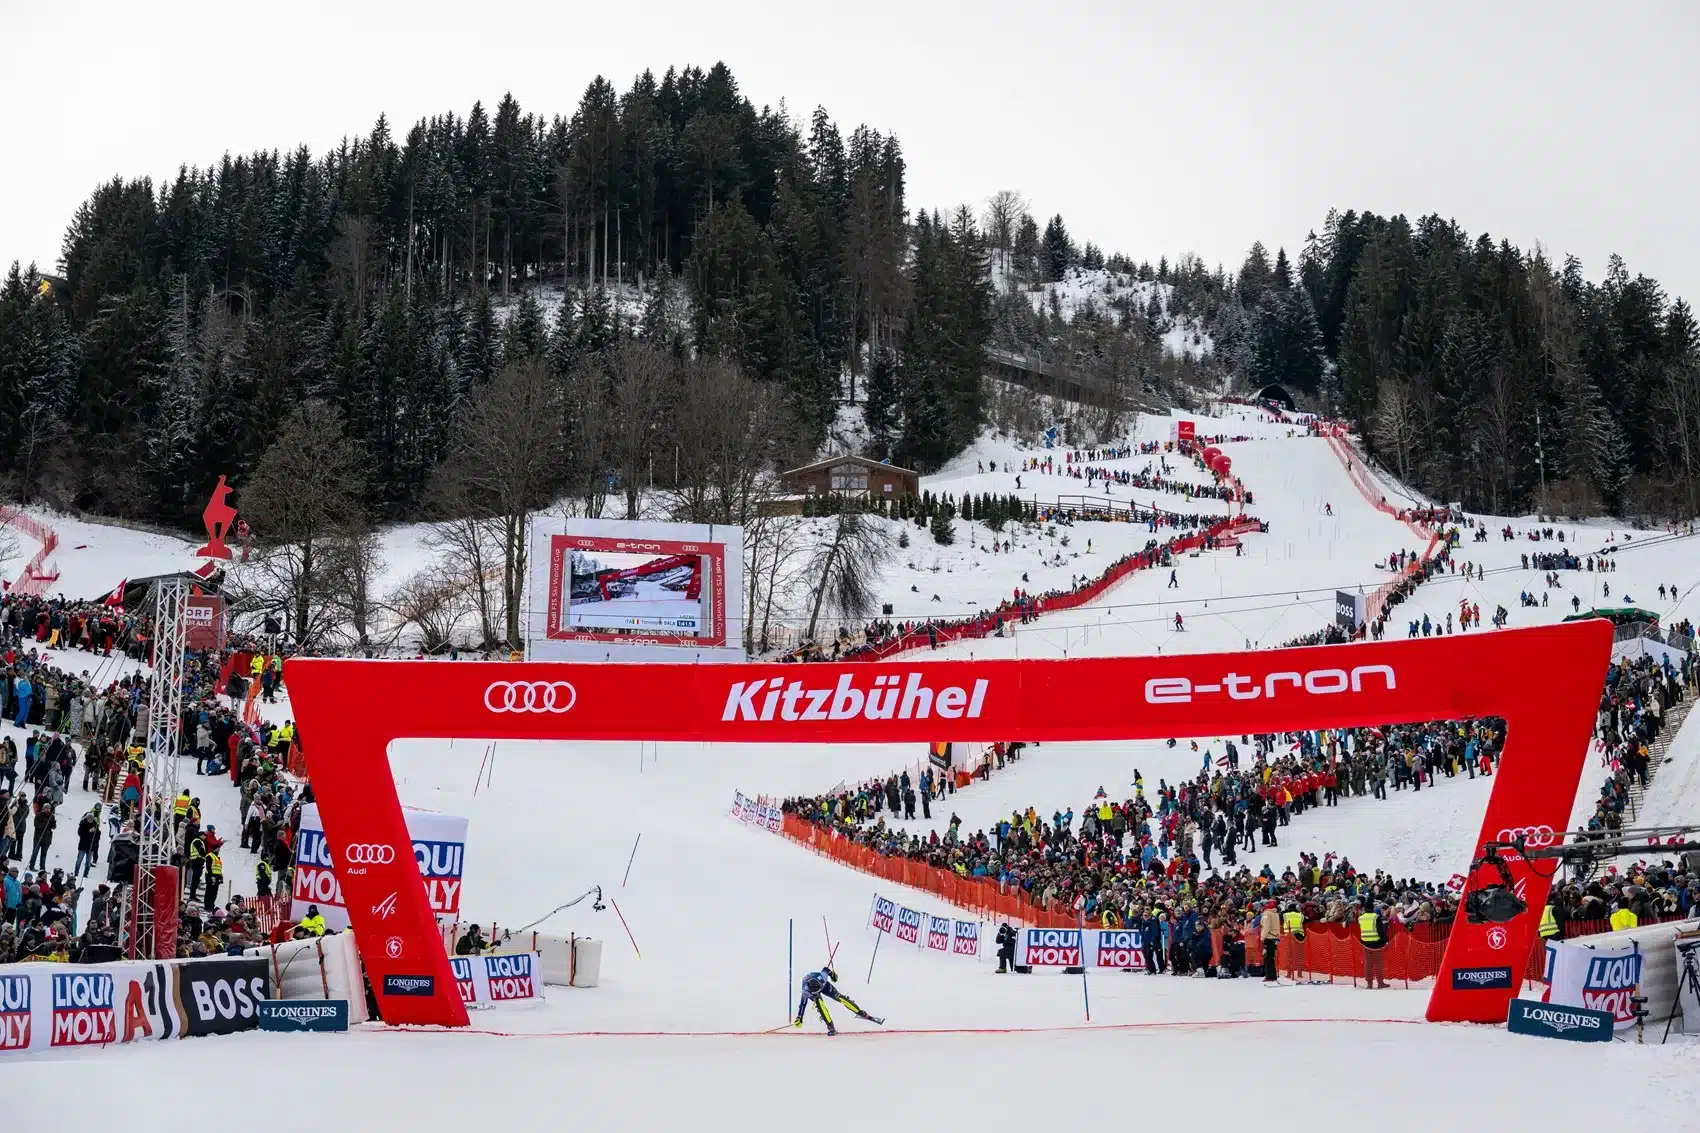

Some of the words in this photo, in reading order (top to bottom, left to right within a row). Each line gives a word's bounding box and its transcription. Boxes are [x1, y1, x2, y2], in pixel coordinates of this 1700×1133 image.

[616, 542, 660, 550] e-tron
[187, 609, 211, 617] ORF
[1336, 602, 1354, 618] BOSS
[1145, 664, 1396, 704] e-tron
[721, 672, 989, 721] Kitzbühel
[412, 843, 461, 876] QUI
[347, 867, 367, 875] Audi
[900, 908, 920, 928] LIQUI
[931, 917, 949, 934] LIQUI
[897, 924, 917, 943] MOLY
[956, 922, 977, 939] LIQUI
[1030, 931, 1078, 947] LIQUI
[929, 933, 948, 950] MOLY
[954, 939, 977, 954] MOLY
[1101, 932, 1143, 949] LIQU
[1028, 948, 1079, 964] MOLY
[487, 956, 528, 977] LIQUI
[1457, 970, 1507, 980] LONGINES
[388, 978, 430, 987] LONGINES
[490, 977, 531, 999] MOLY
[55, 976, 111, 1008] LIQUI
[192, 978, 264, 1020] BOSS
[271, 1006, 337, 1018] LONGINES
[1522, 1007, 1600, 1029] LONGINES
[54, 1011, 114, 1043] MOLY
